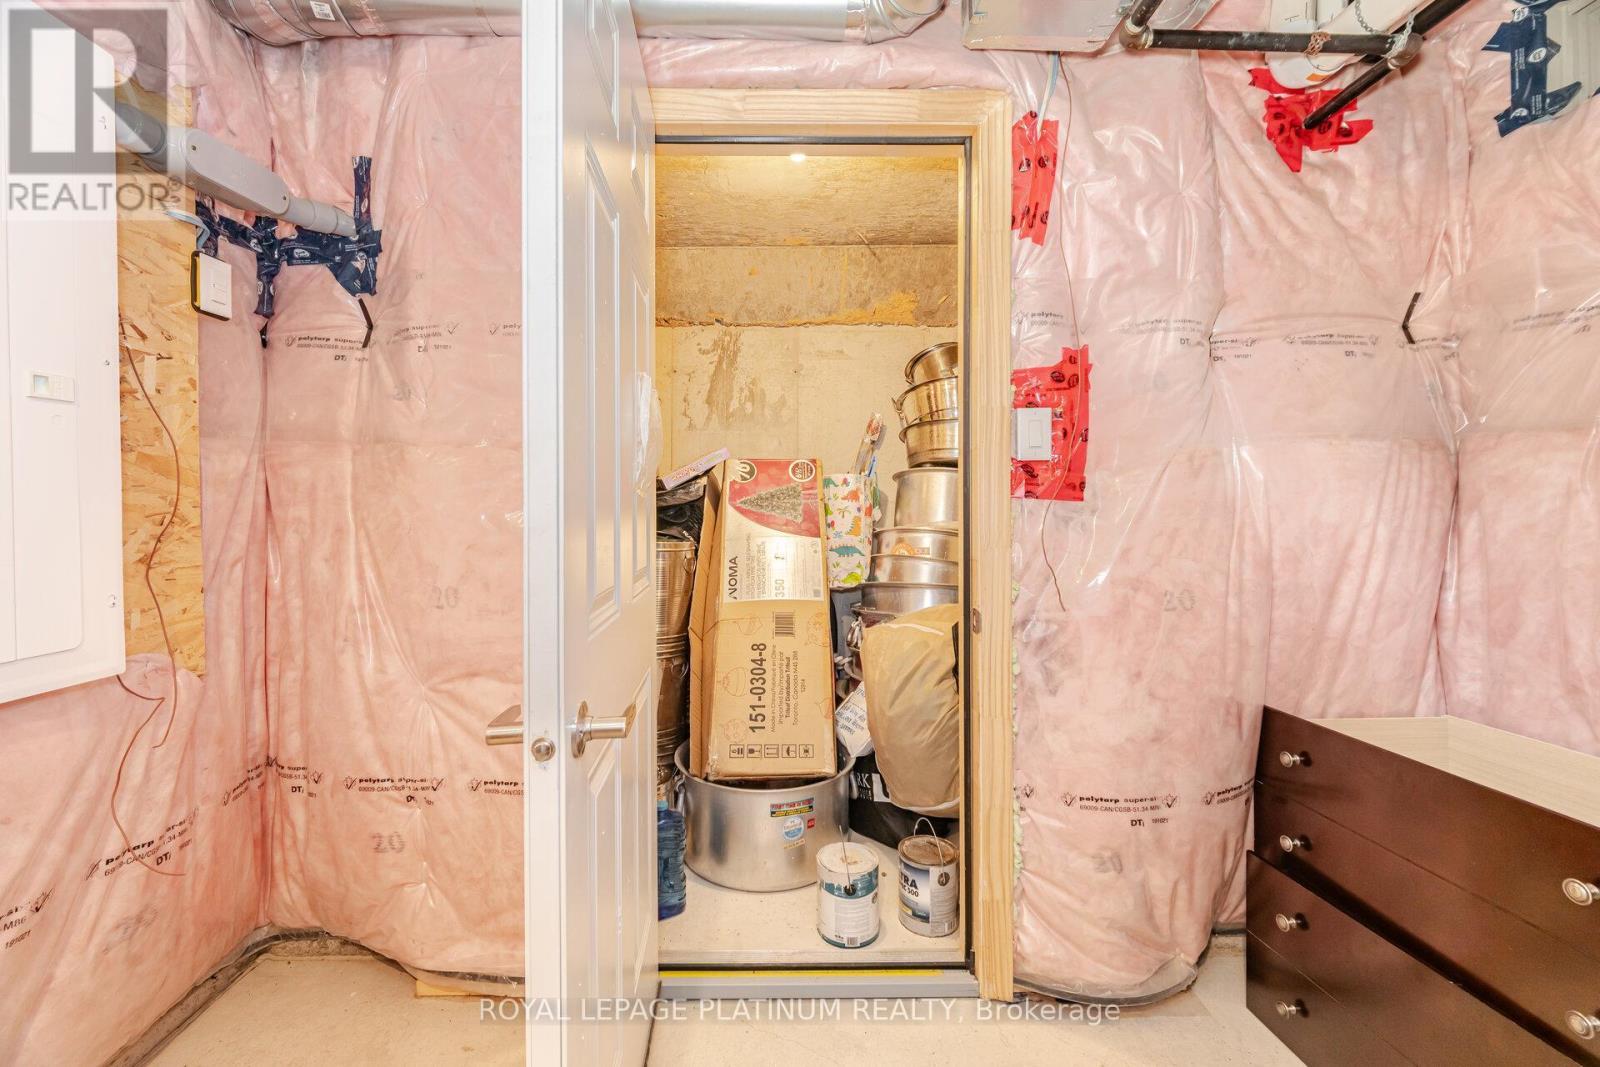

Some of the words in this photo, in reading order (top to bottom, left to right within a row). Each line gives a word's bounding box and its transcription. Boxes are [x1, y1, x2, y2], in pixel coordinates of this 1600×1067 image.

[728, 556, 738, 600] NOMA
[749, 642, 766, 733] 151-0304-8
[1079, 796, 1120, 804] polytarp
[371, 832, 406, 854] 20
